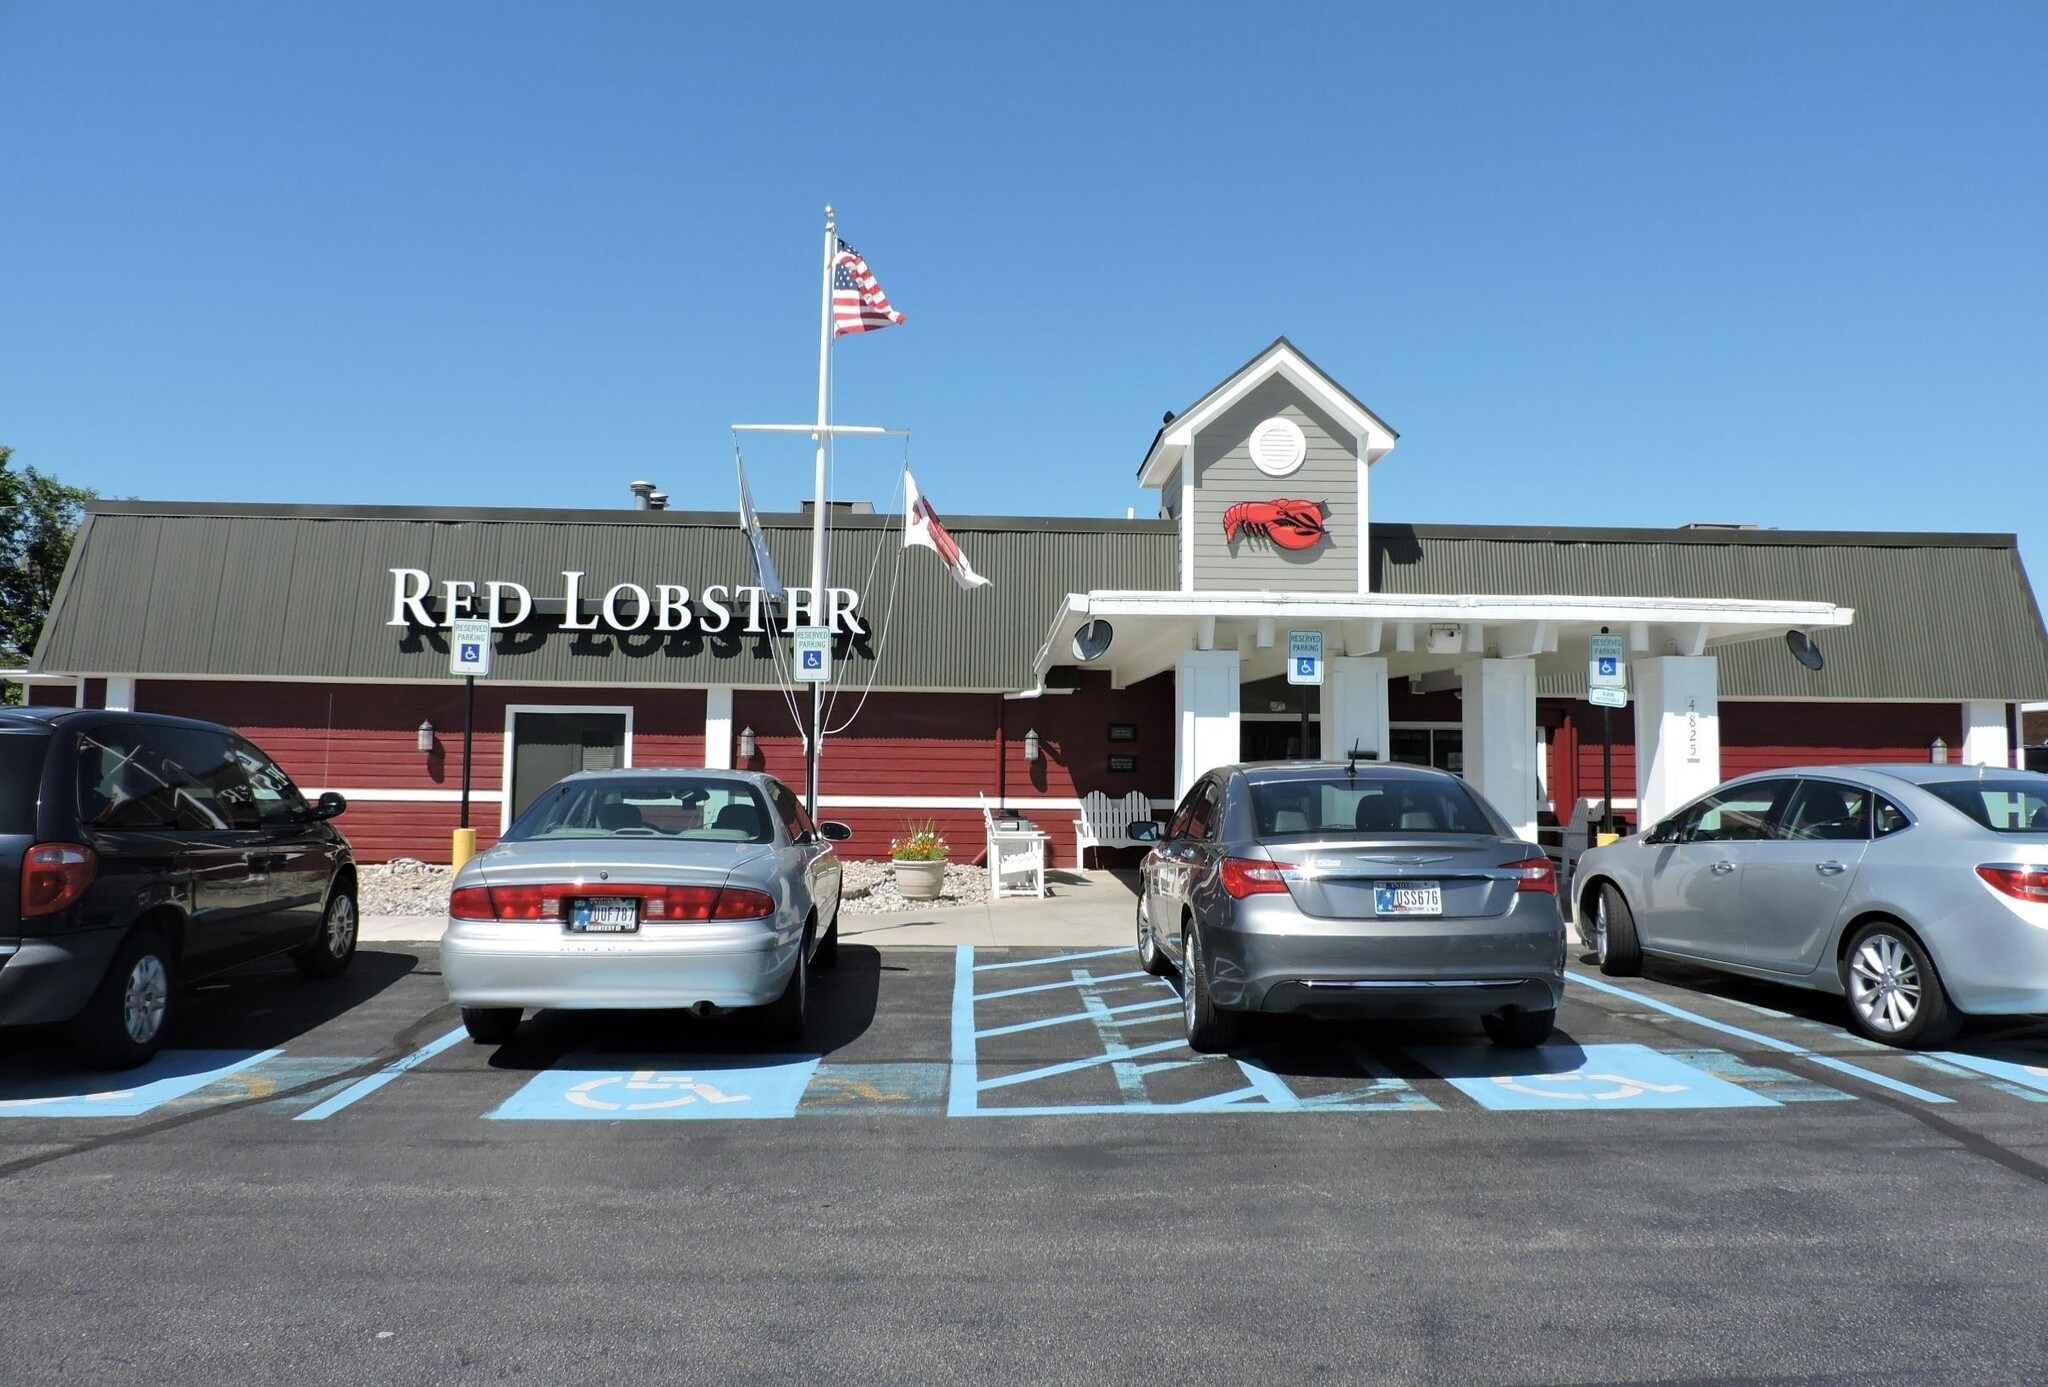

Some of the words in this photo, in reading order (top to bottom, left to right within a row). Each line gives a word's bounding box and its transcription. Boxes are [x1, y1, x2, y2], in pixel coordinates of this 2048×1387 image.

[386, 568, 532, 628] RED
[558, 571, 866, 634] LOBSTER
[455, 624, 488, 632] RESERVED
[457, 633, 486, 641] PARKING
[797, 631, 828, 639] RESERVED
[1290, 634, 1320, 643] RESERVED
[1592, 638, 1622, 646] RESERVED
[1292, 644, 1319, 652] PARKING
[1594, 647, 1620, 655] PARKING
[1688, 699, 1697, 756] 4825
[1396, 890, 1438, 905] USS676
